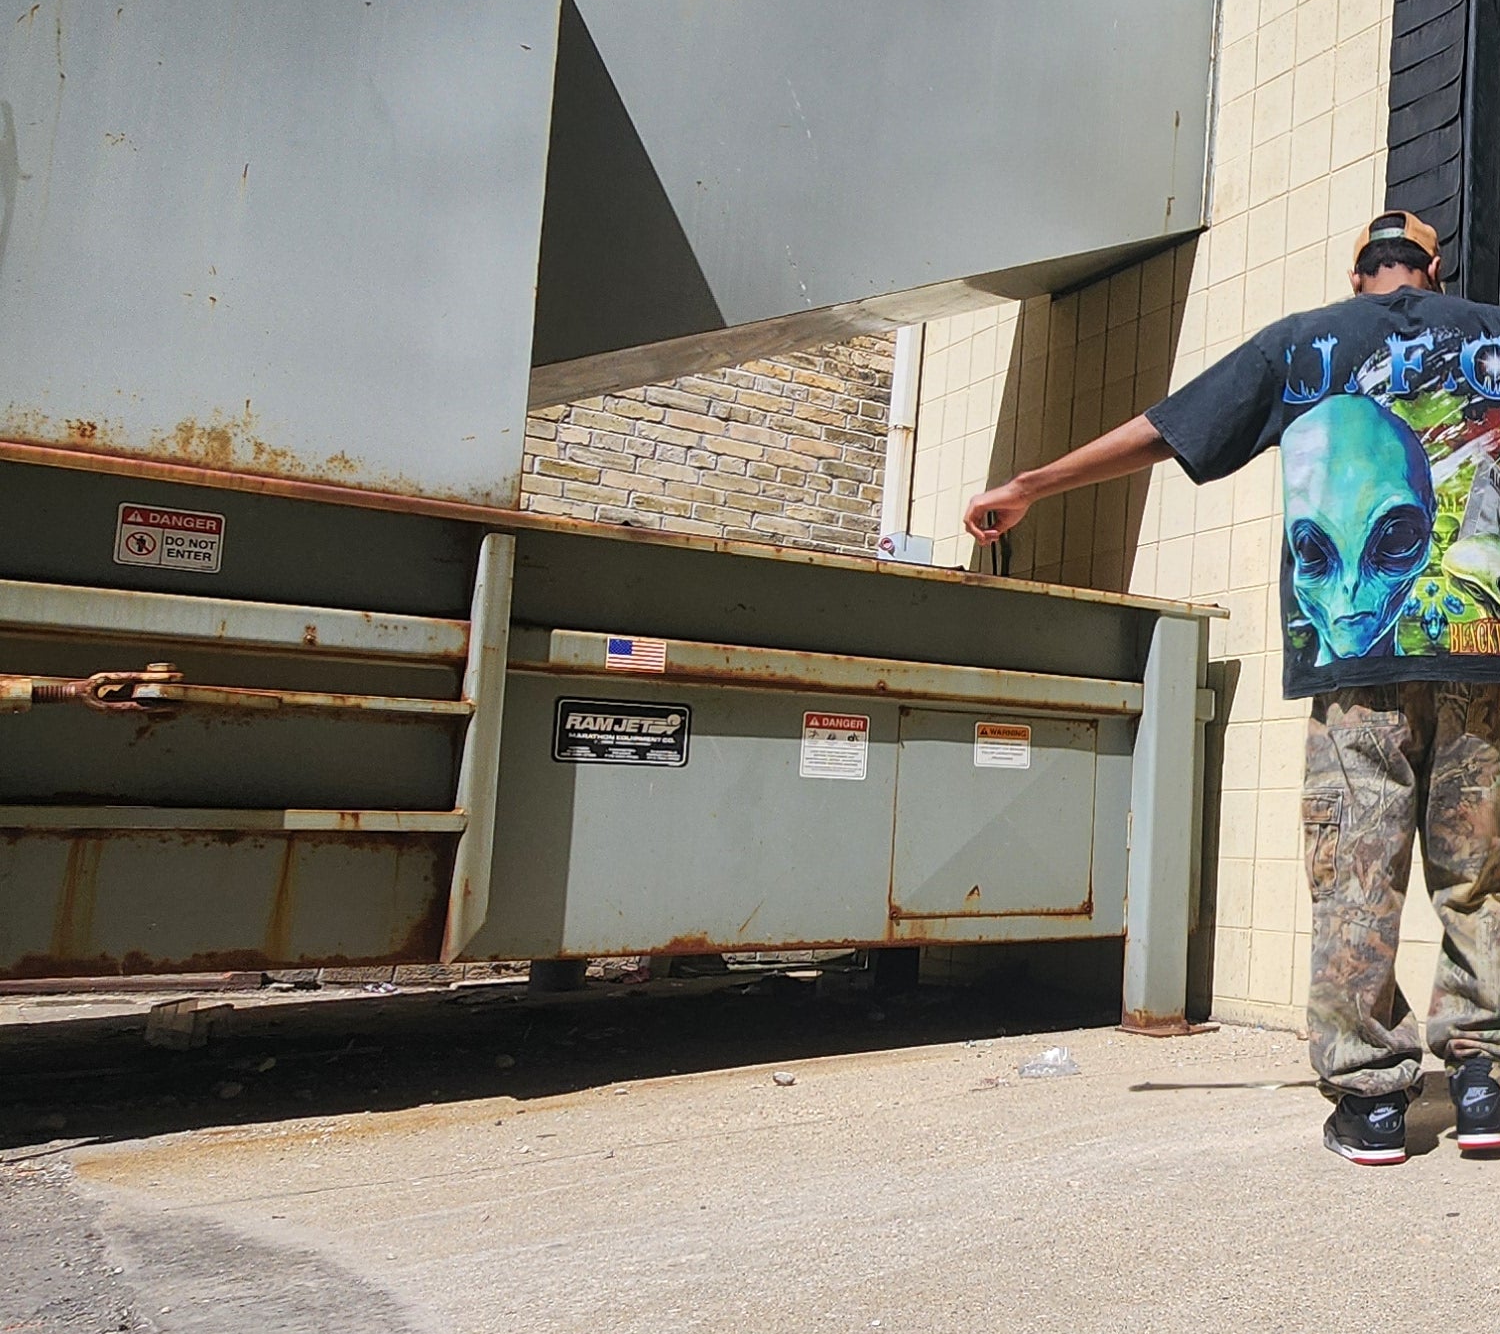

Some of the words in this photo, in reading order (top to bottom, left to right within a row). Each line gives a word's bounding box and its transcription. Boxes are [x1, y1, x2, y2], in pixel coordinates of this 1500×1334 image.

[149, 512, 217, 531] DANGER
[165, 536, 185, 547] DO
[189, 538, 217, 551] NOT
[167, 548, 212, 562] ENTER
[822, 717, 864, 729] DANGER
[990, 728, 1027, 737] WARNING
